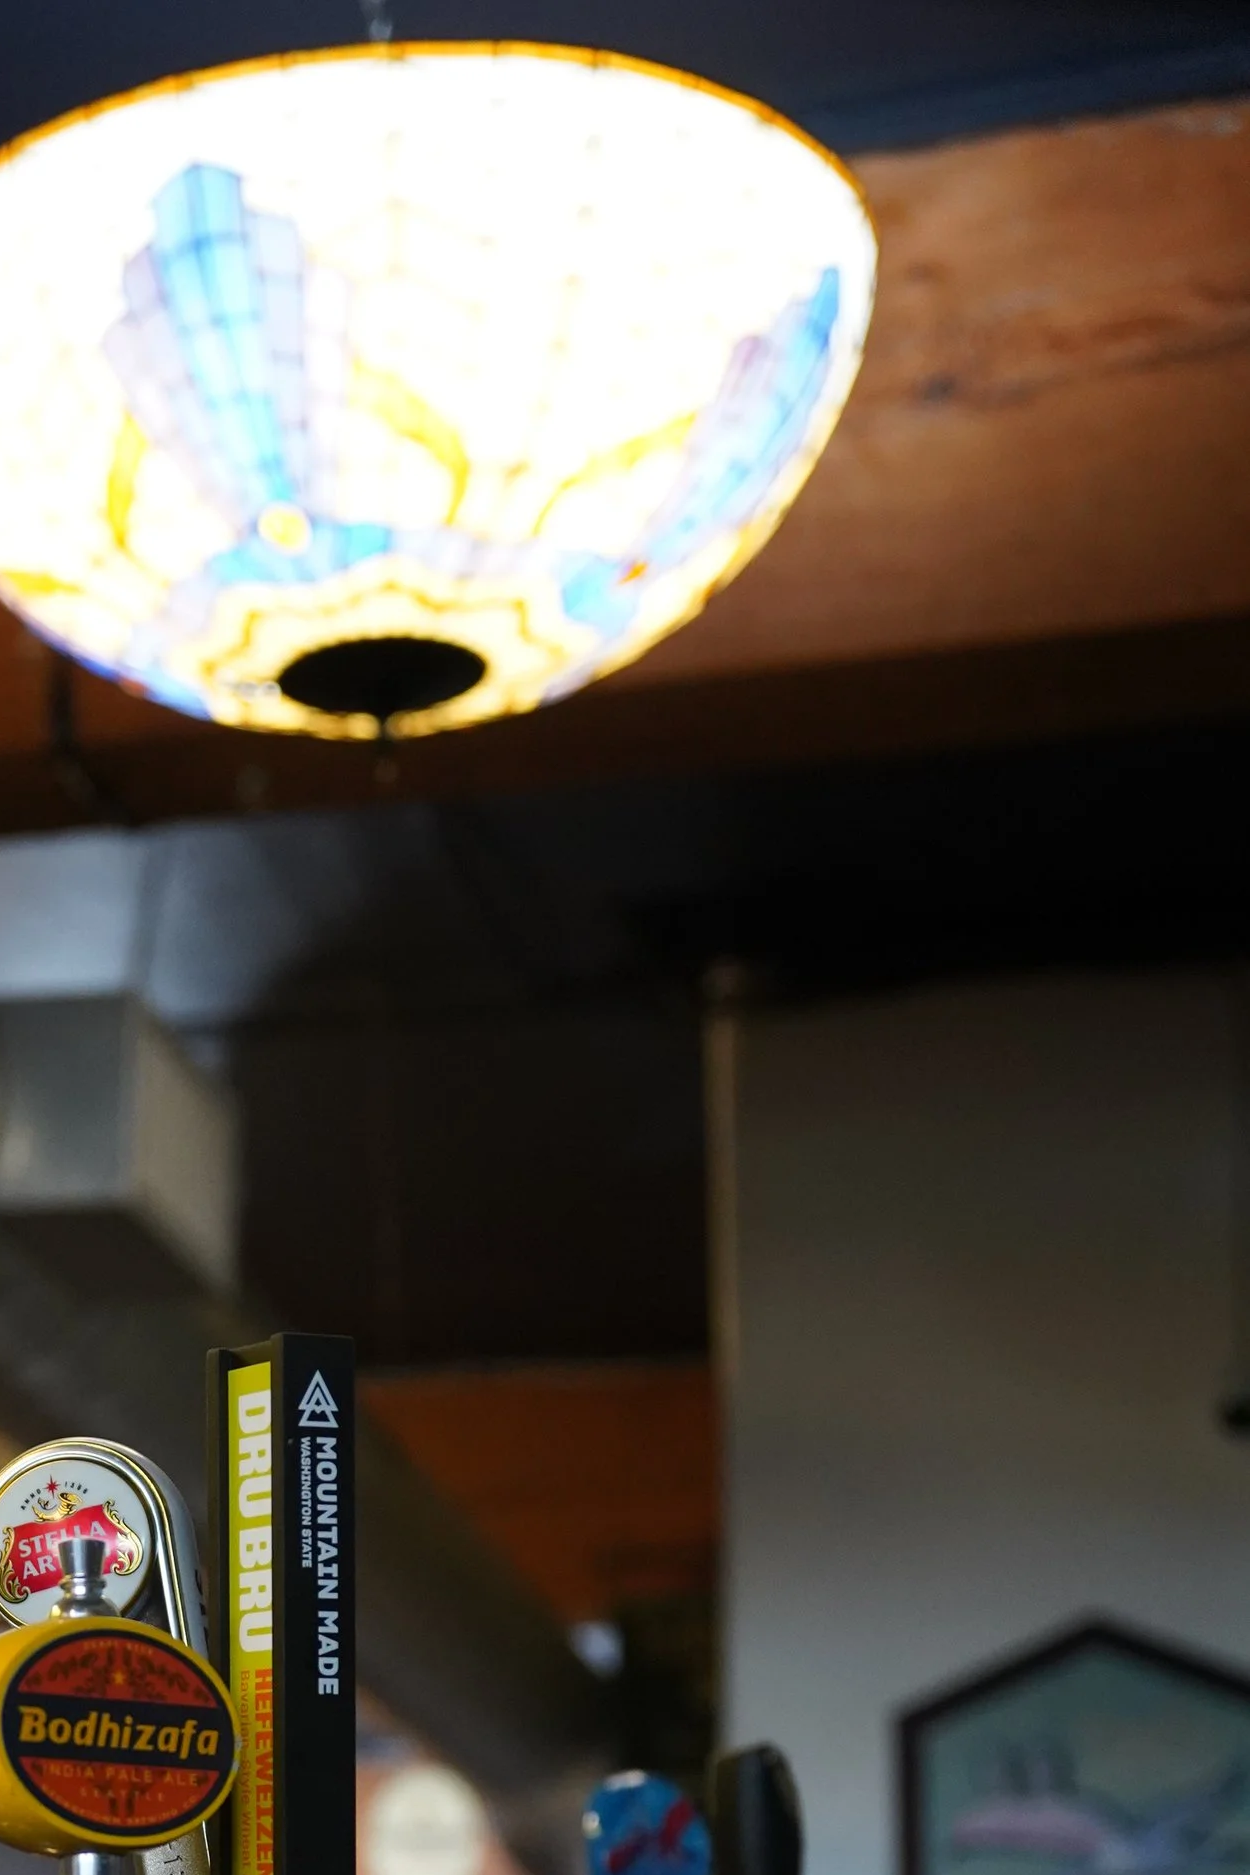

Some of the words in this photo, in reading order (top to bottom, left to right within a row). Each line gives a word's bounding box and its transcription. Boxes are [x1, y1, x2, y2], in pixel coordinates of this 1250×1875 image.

[238, 1389, 272, 1518] DRU
[300, 1436, 312, 1526] WASHINGTON
[301, 1529, 313, 1569] STATE
[316, 1436, 339, 1599] MOUNTAIN
[239, 1525, 273, 1653] BRU
[317, 1610, 340, 1696] MADE
[18, 1705, 220, 1761] Bodhizafa
[41, 1763, 95, 1780] INDIA
[105, 1765, 154, 1784] PALE
[163, 1769, 199, 1787] ALE
[79, 1785, 165, 1803] SEATTLE
